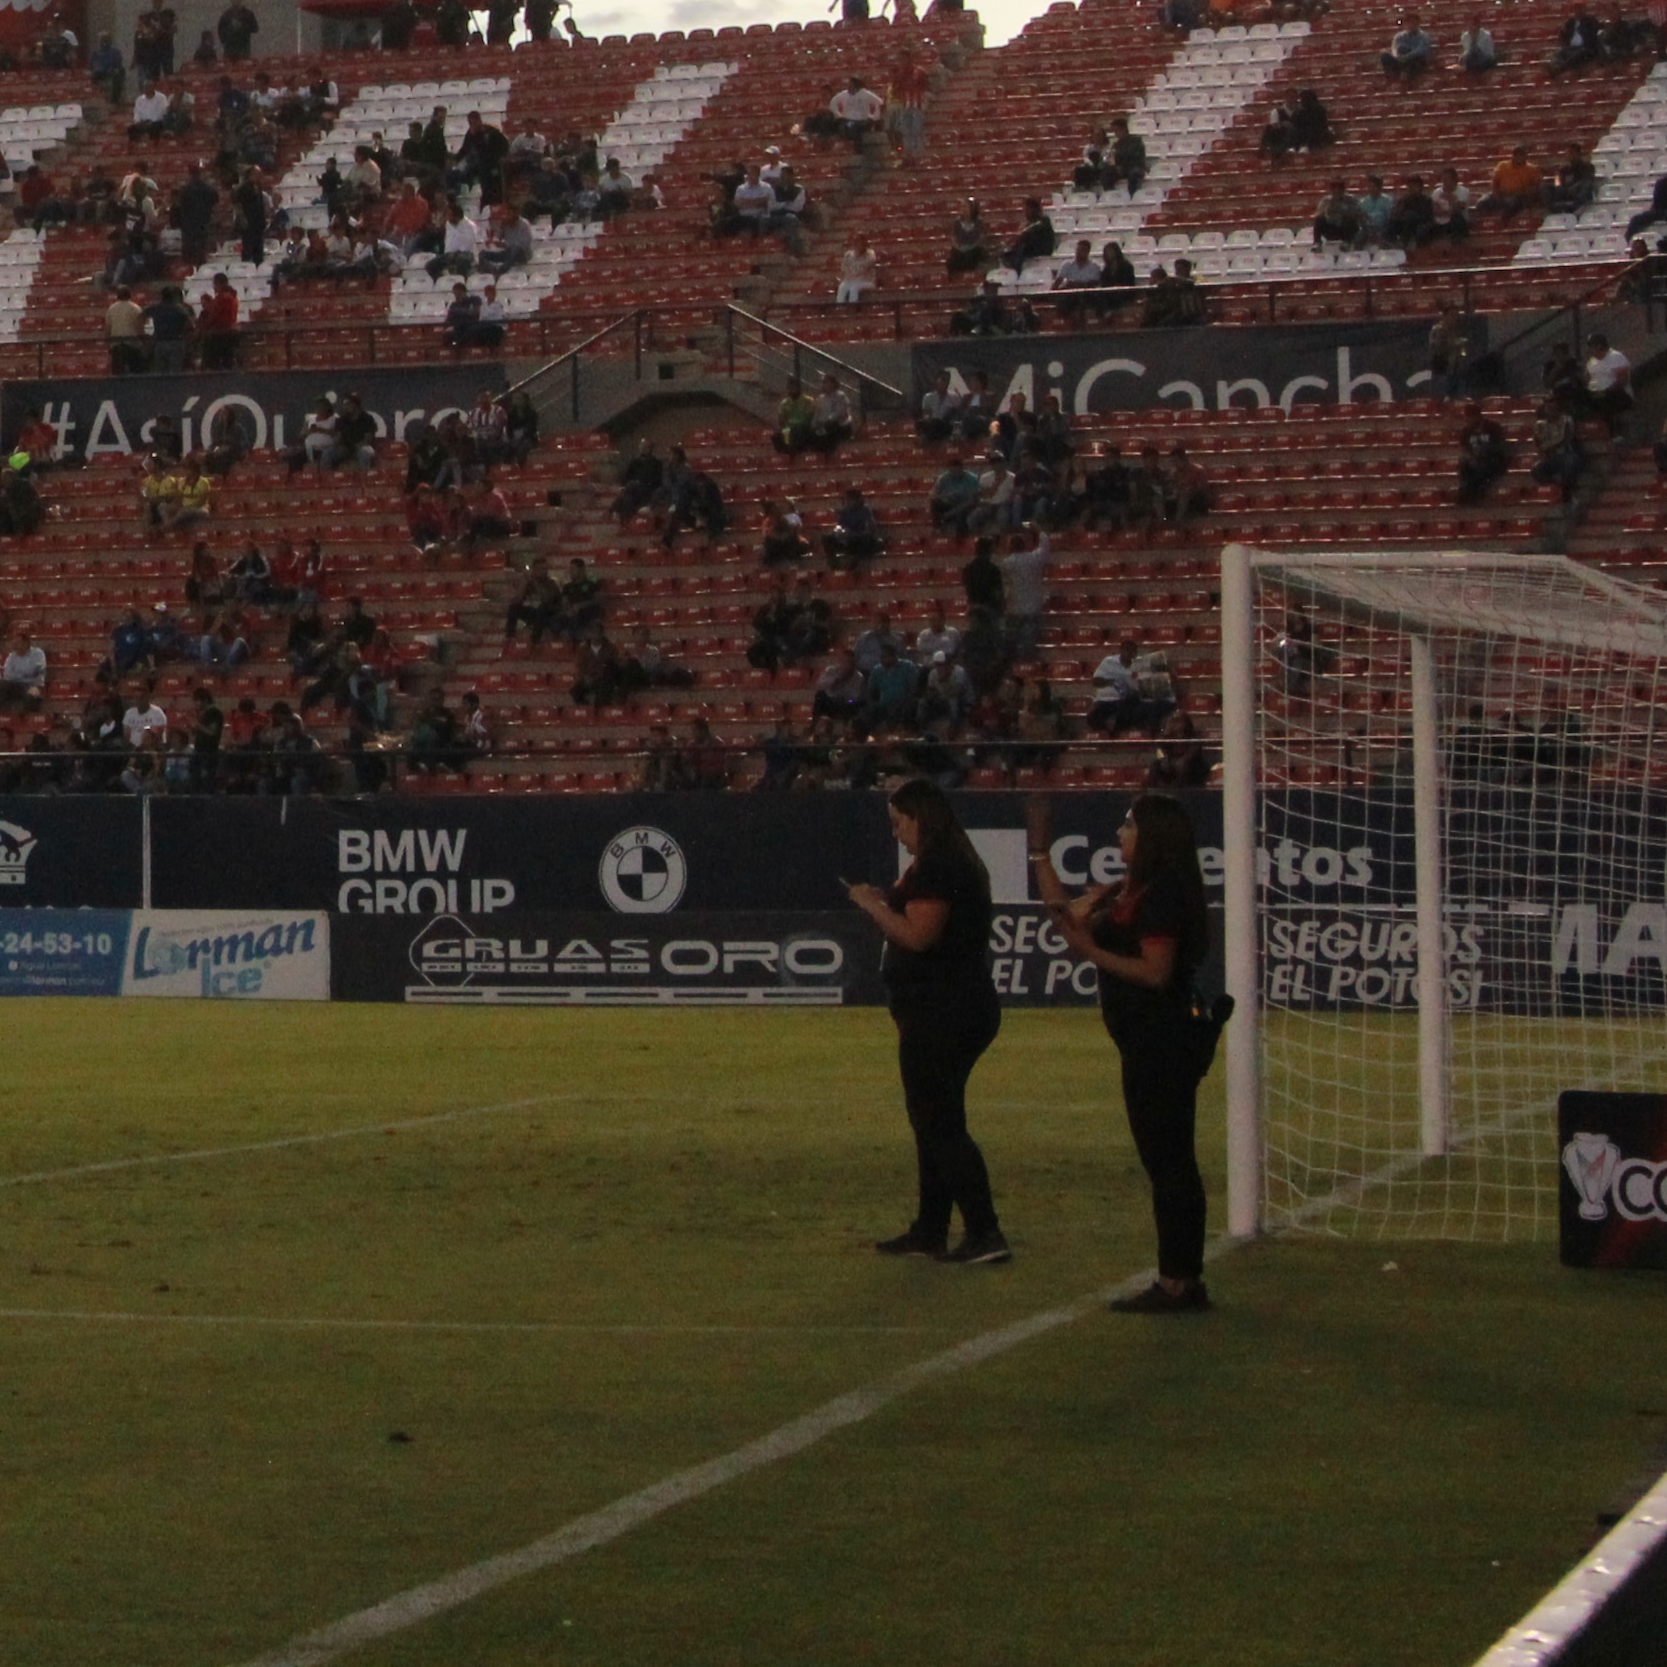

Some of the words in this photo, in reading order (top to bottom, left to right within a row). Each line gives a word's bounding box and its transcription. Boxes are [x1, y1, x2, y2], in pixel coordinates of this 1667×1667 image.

[338, 830, 467, 873] BMW
[610, 832, 677, 860] BMW
[338, 879, 515, 914] GROUP
[660, 939, 844, 975] ORO
[1269, 964, 1311, 1002] EL
